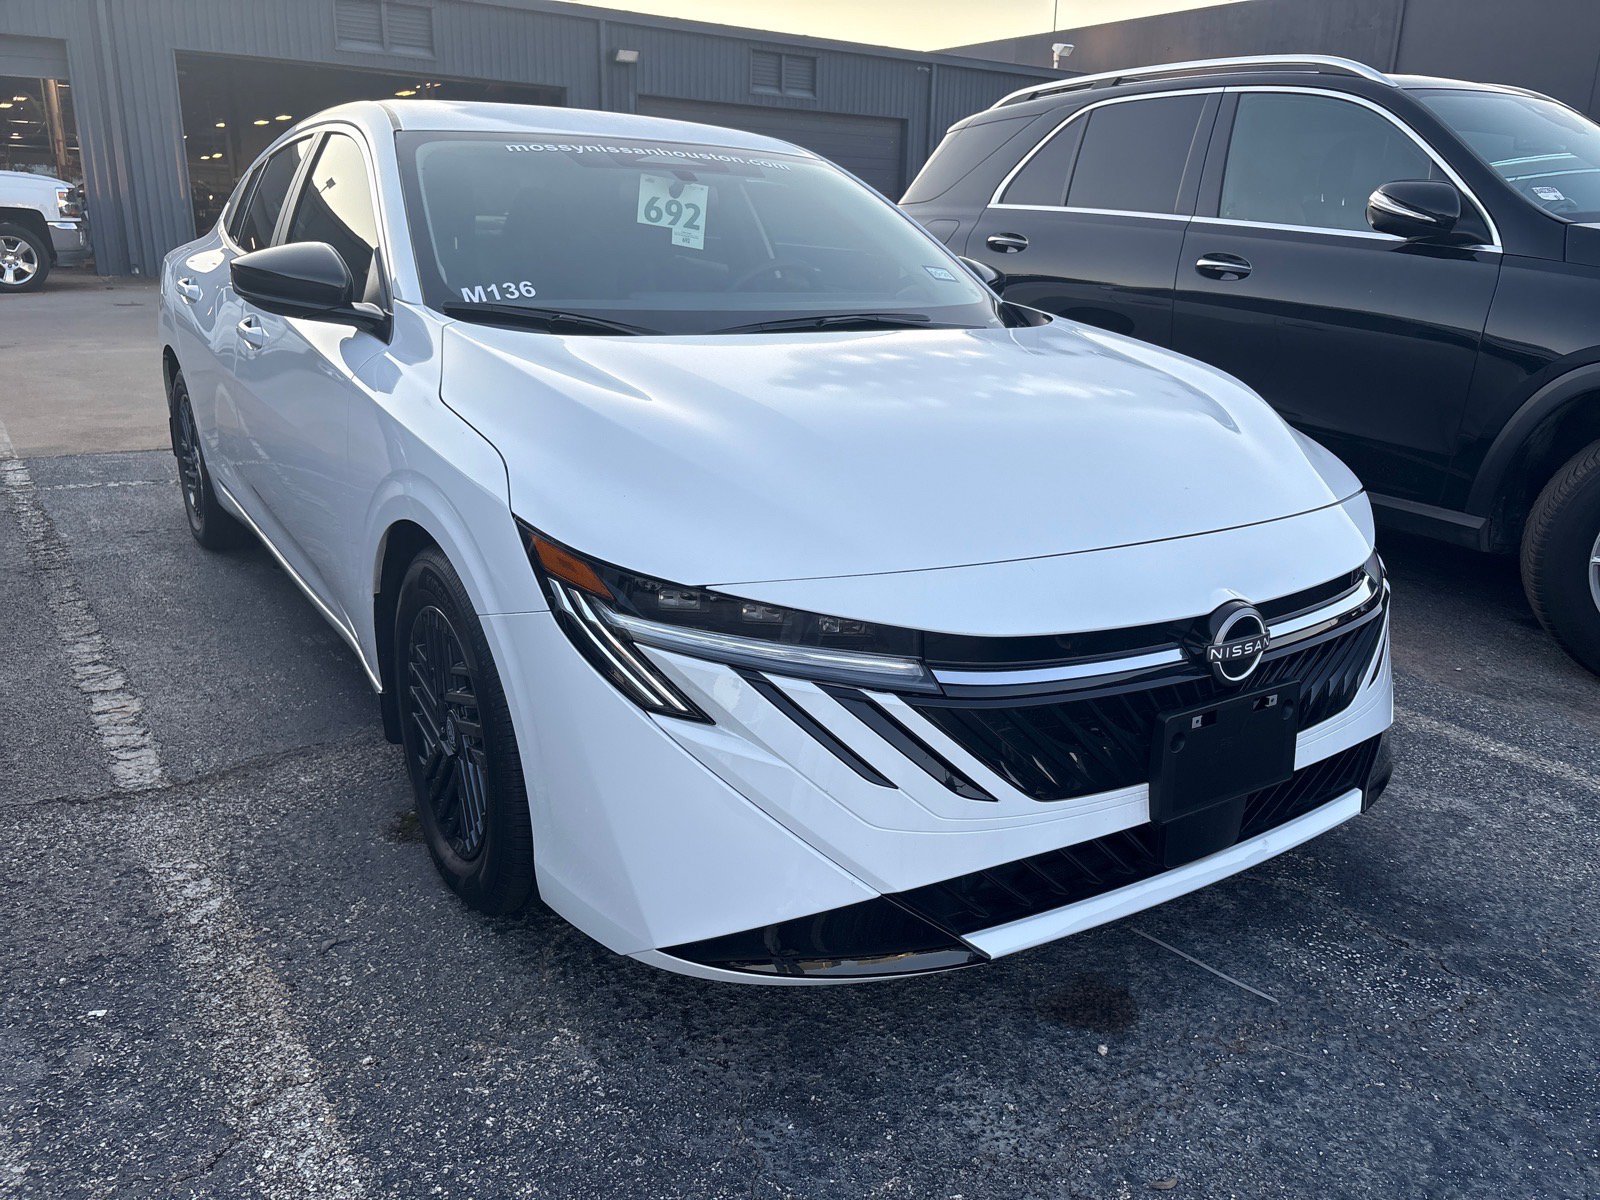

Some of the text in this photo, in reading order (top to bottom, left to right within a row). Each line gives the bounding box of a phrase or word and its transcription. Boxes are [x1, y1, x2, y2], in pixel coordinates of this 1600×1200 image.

[506, 143, 791, 171] mossynissanhouston.com
[644, 196, 701, 231] 692
[461, 281, 536, 303] M136
[1210, 637, 1270, 660] NISSAN
